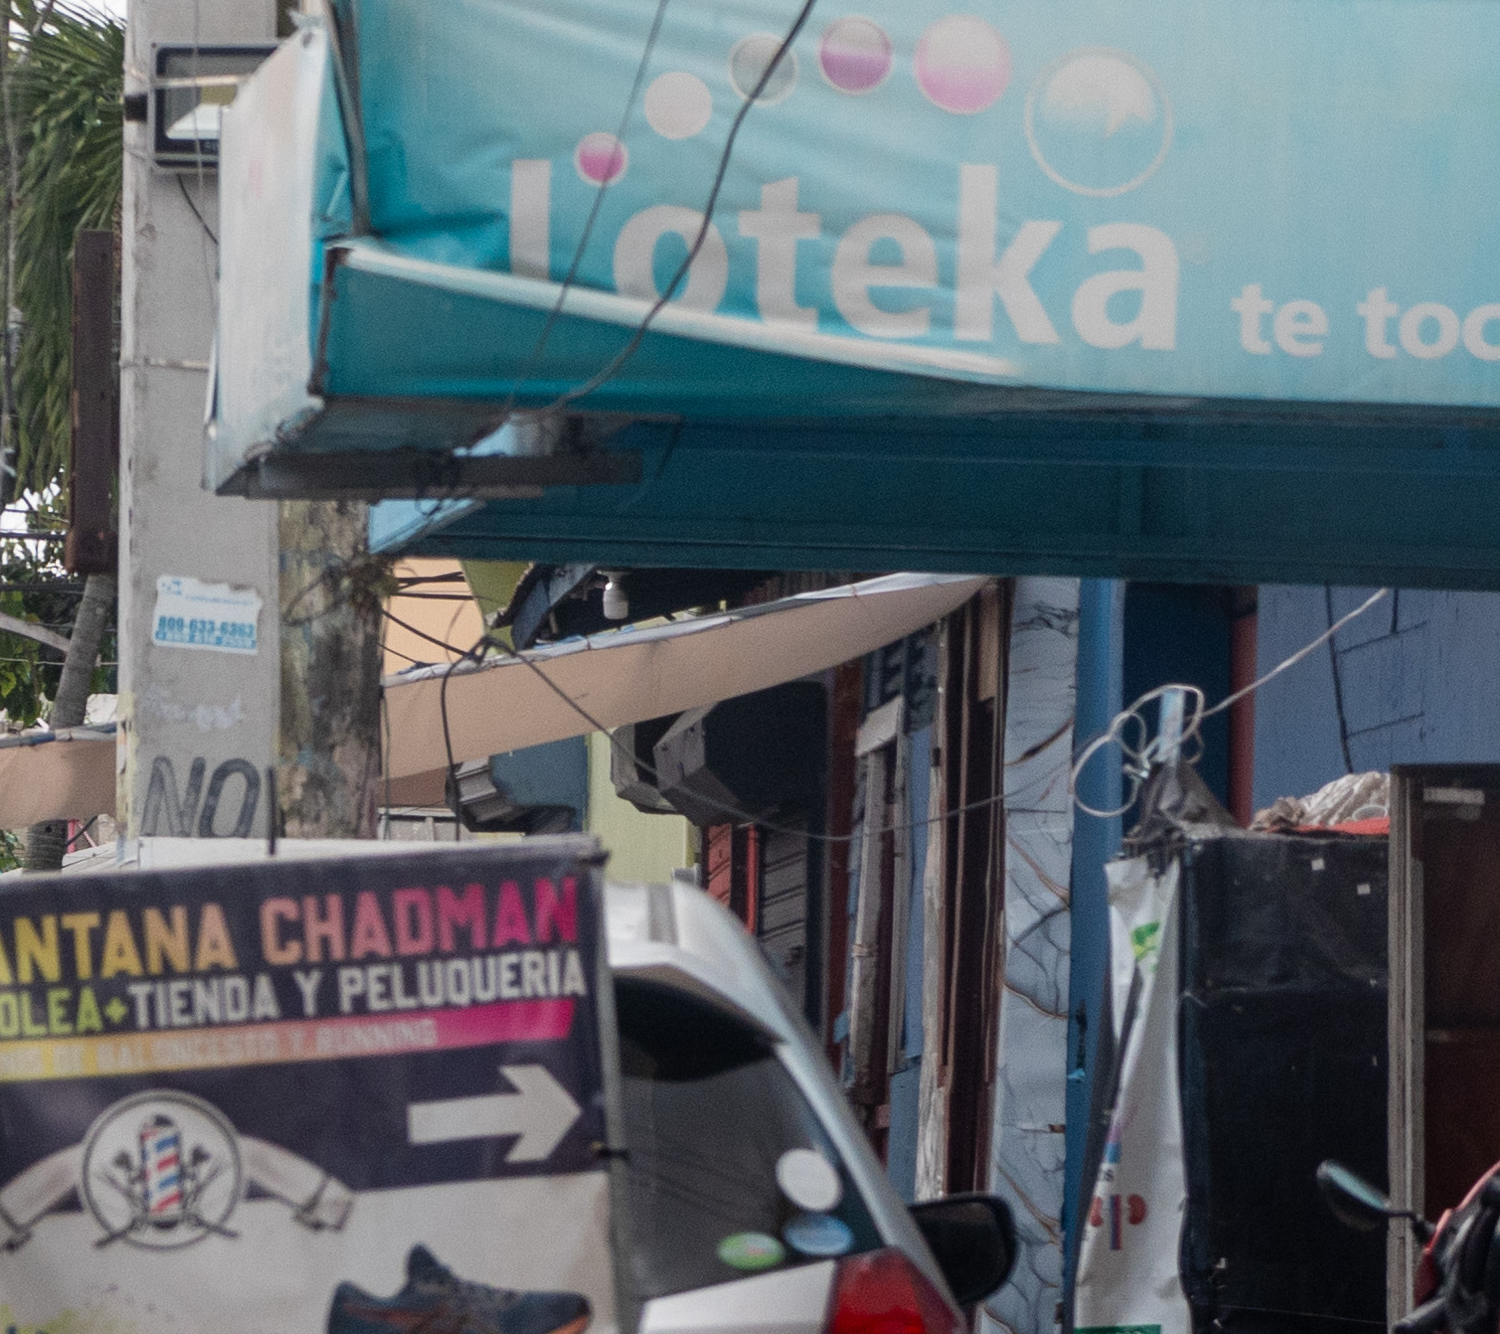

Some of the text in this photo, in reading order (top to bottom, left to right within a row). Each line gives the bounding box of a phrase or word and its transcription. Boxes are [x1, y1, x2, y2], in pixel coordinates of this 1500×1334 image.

[1231, 282, 1329, 358] te
[259, 876, 579, 966] CHADMAN
[294, 968, 323, 1017] Y
[338, 949, 588, 1015] PELUQUERIA
